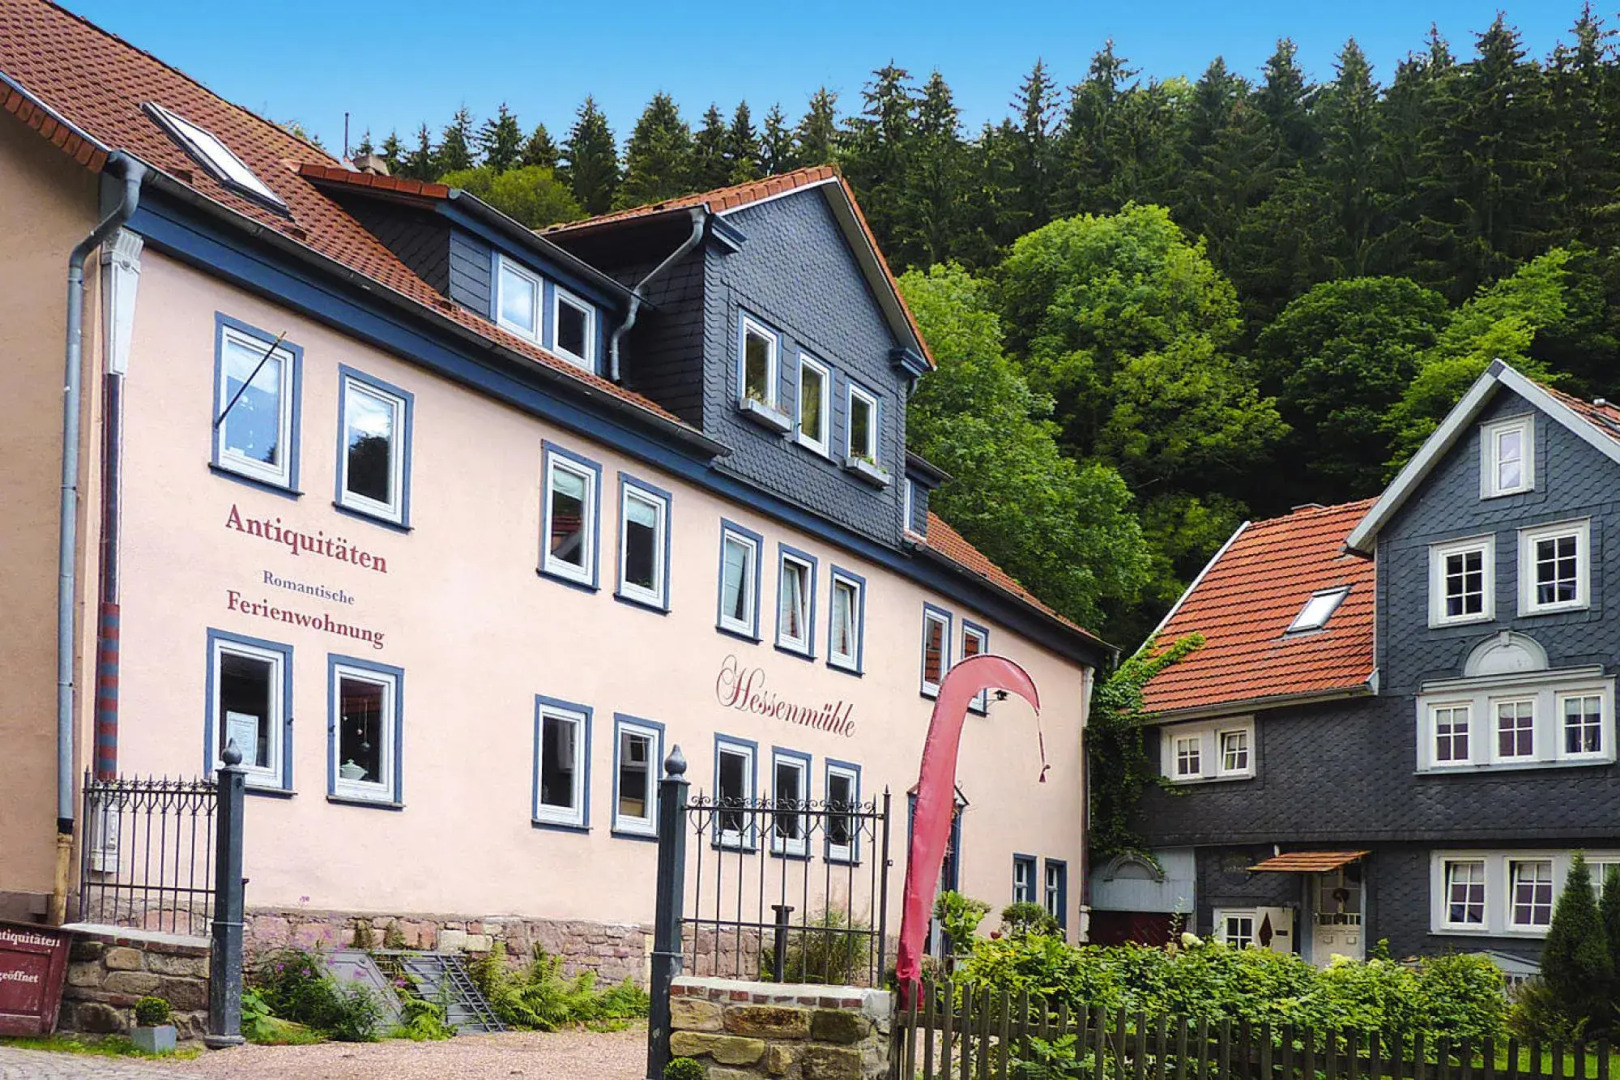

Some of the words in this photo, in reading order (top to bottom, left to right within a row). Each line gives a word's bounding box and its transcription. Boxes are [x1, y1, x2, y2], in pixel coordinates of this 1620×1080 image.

[225, 503, 387, 573] Antiquitäten
[263, 570, 355, 605] Romantische
[226, 589, 385, 649] Ferienwohnung
[716, 654, 856, 738] Hessenmühle
[0, 929, 60, 947] tiquitäten
